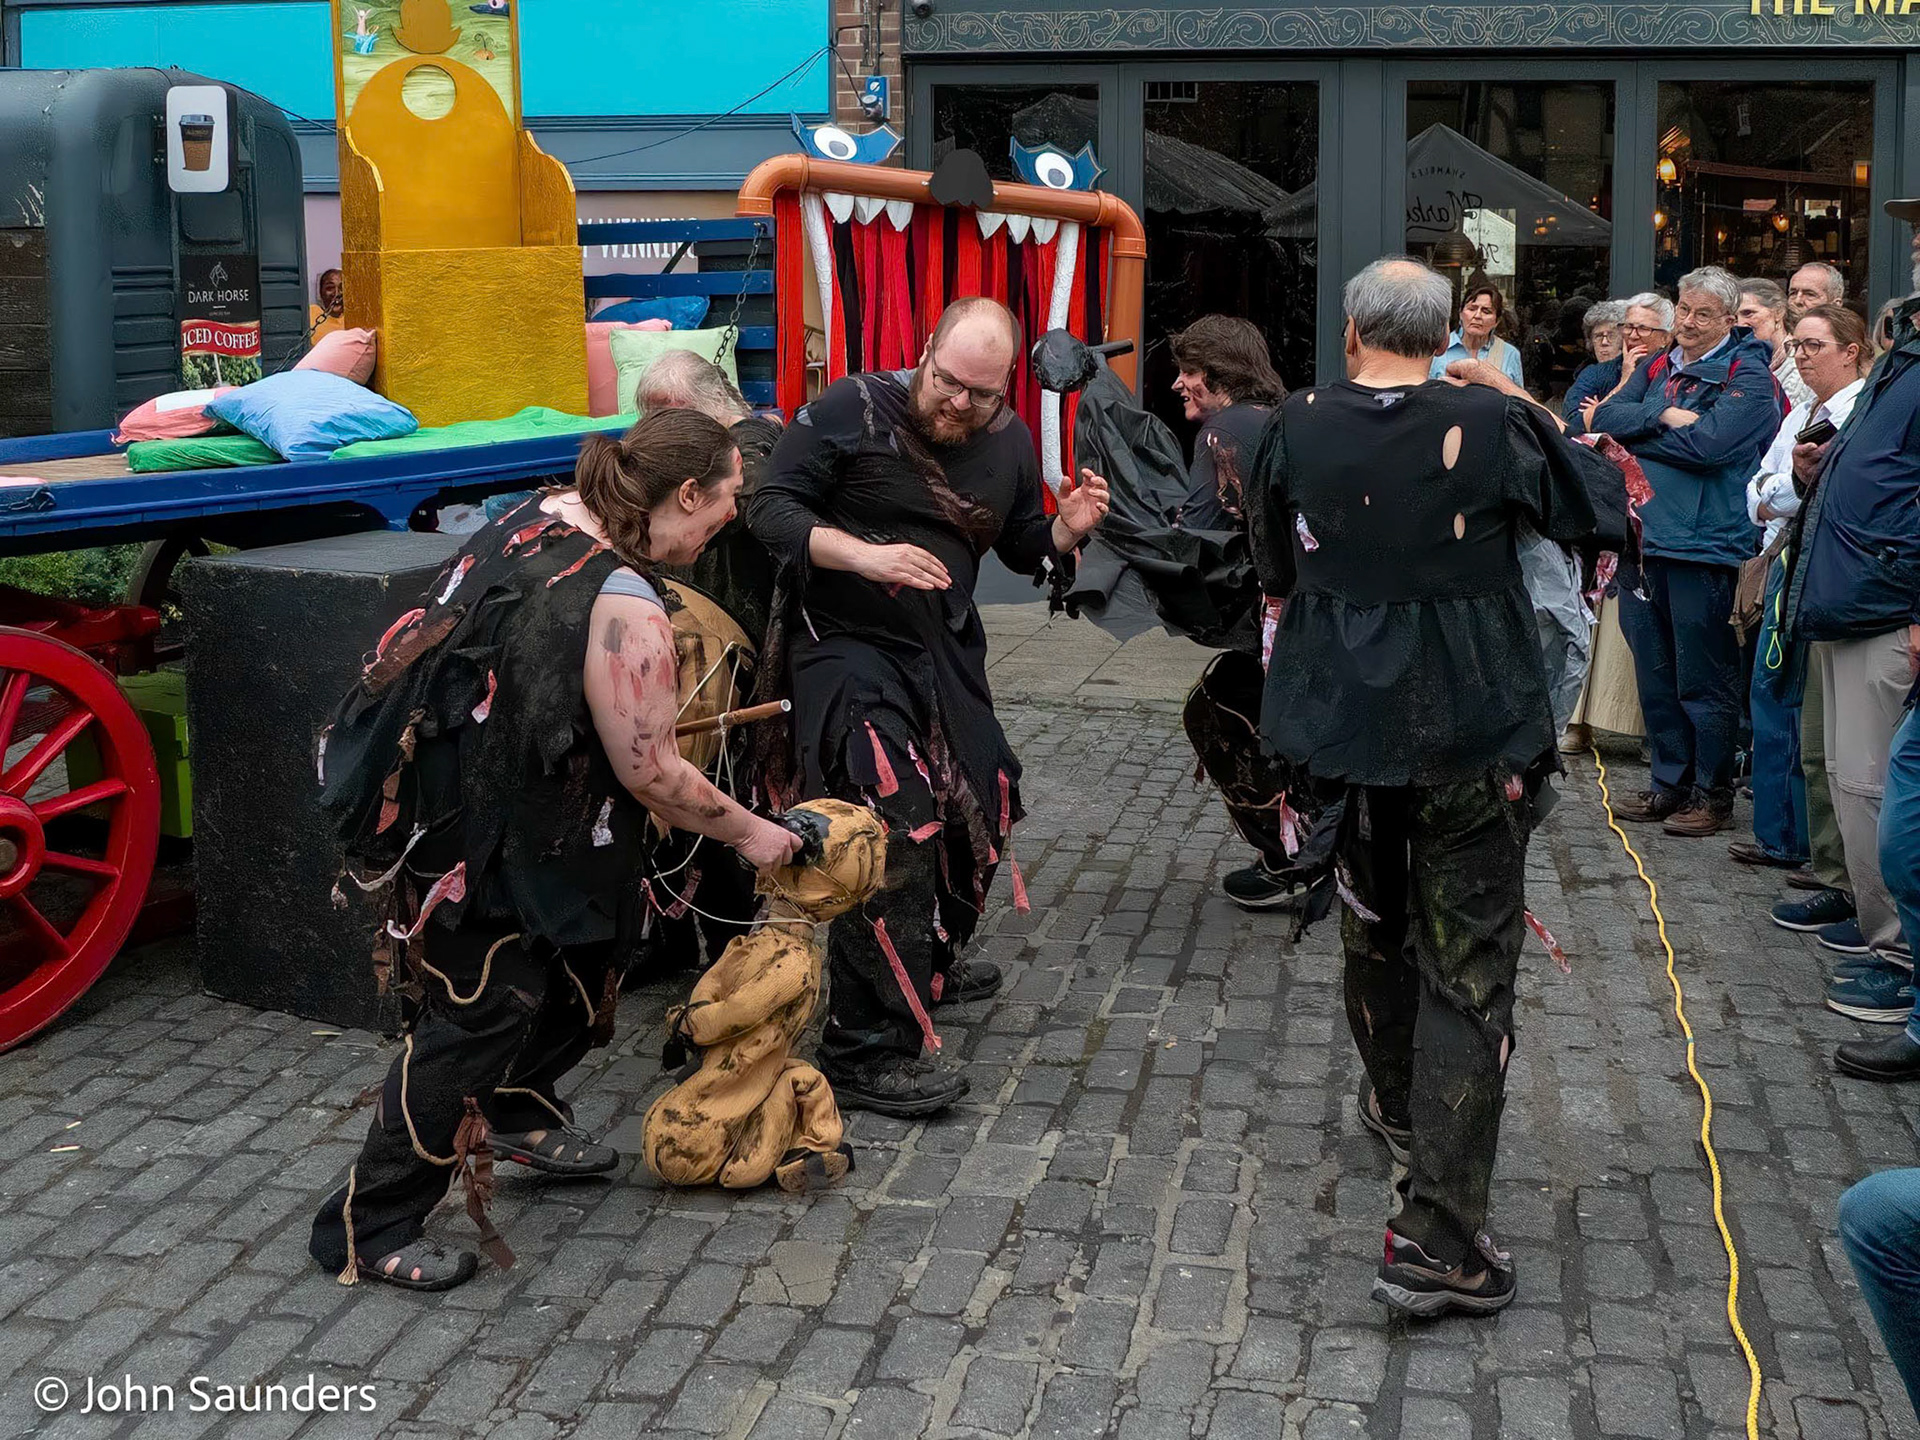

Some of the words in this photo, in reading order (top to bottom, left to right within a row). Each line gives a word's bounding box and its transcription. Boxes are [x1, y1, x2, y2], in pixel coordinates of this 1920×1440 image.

[187, 290, 214, 304] DARK
[217, 289, 250, 302] HORSE
[182, 328, 212, 348] ICED
[214, 330, 259, 349] COFFEE
